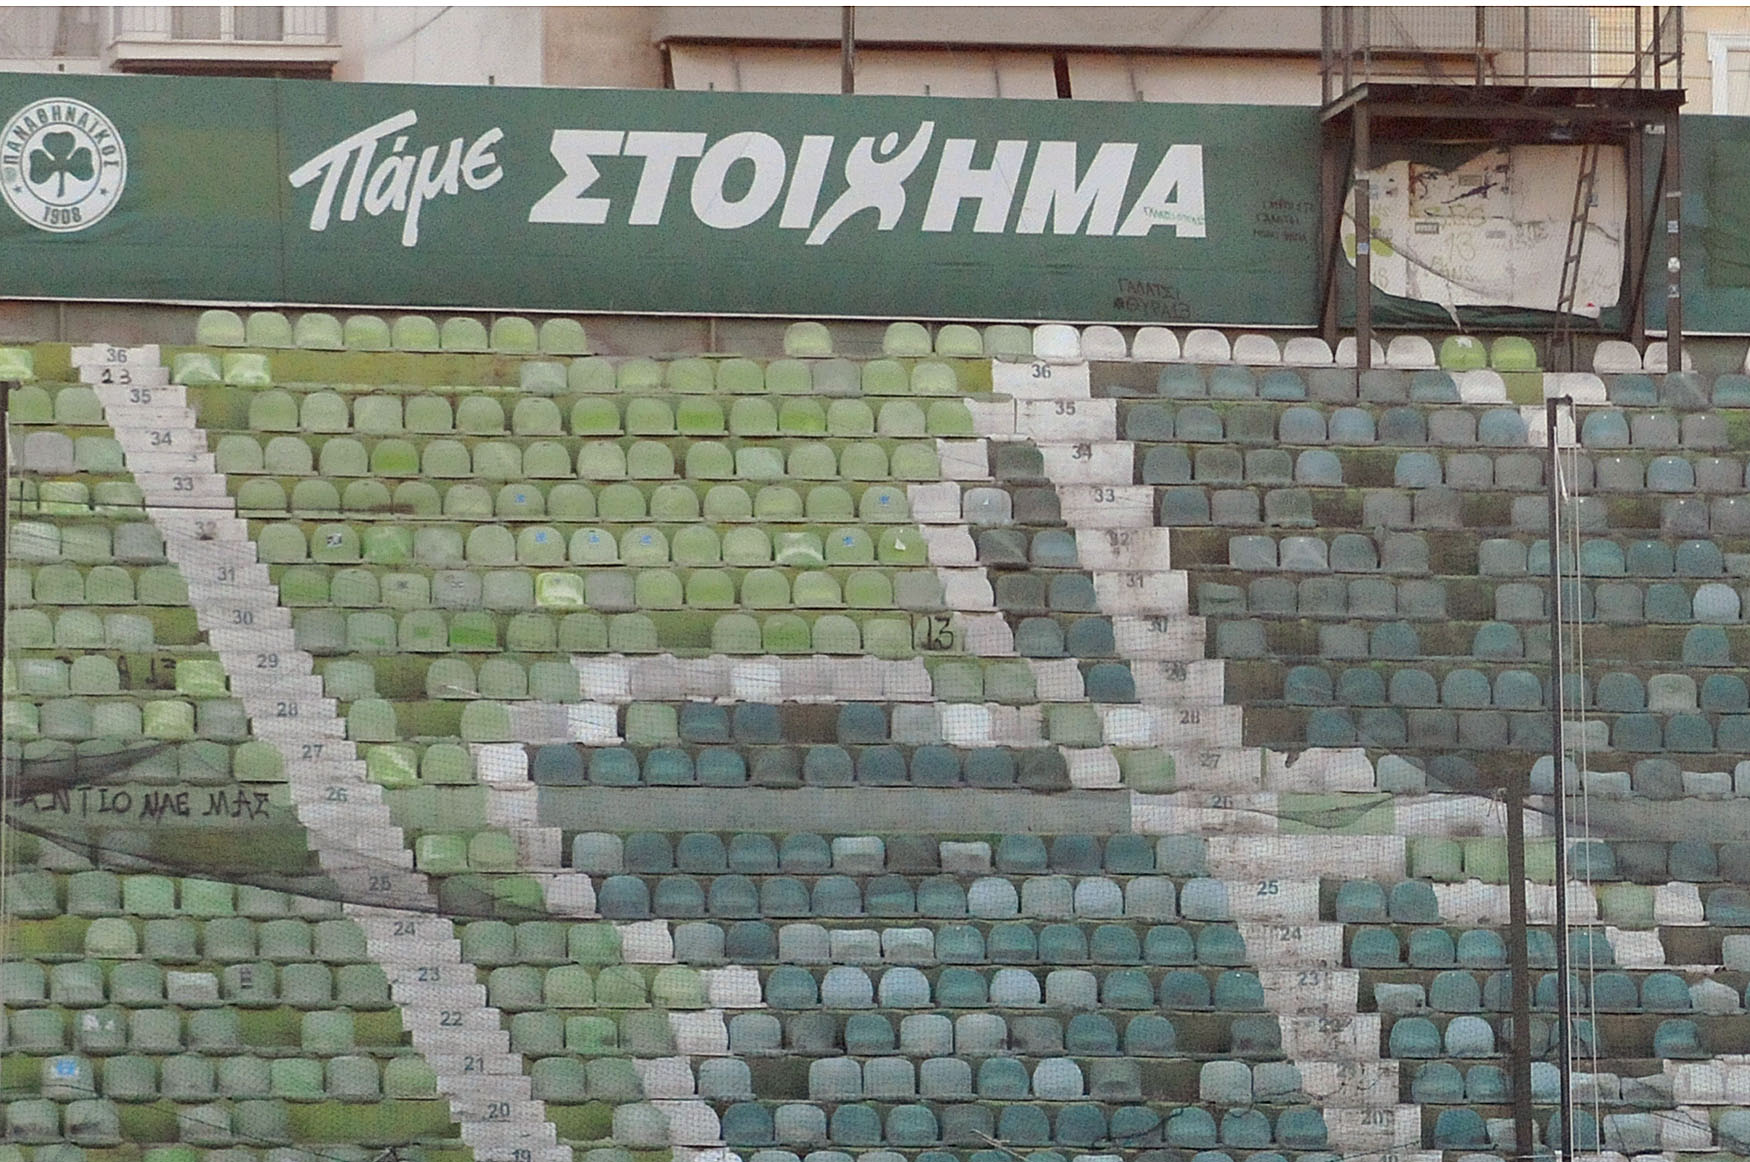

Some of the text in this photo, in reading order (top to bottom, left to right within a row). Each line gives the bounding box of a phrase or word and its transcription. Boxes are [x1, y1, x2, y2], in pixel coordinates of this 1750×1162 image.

[288, 109, 1207, 247] Πάμε ΣΤΟΙΧΗΜΑ
[43, 206, 83, 225] 1908
[107, 348, 128, 364] 36
[1032, 363, 1052, 379] 36
[130, 388, 152, 404] 35
[1055, 400, 1076, 416] 35
[151, 431, 173, 447] 34
[173, 476, 194, 491] 33
[1095, 487, 1116, 503] 33
[218, 566, 236, 582] 31
[233, 609, 254, 625] 30
[257, 653, 279, 669] 29
[277, 702, 298, 717] 28
[302, 743, 324, 759] 27
[326, 786, 348, 802] 26
[1257, 879, 1280, 896] 25
[394, 921, 416, 937] 24
[418, 966, 440, 982] 23
[440, 1011, 463, 1026] 22
[464, 1056, 485, 1073] 21
[488, 1102, 510, 1119] 20
